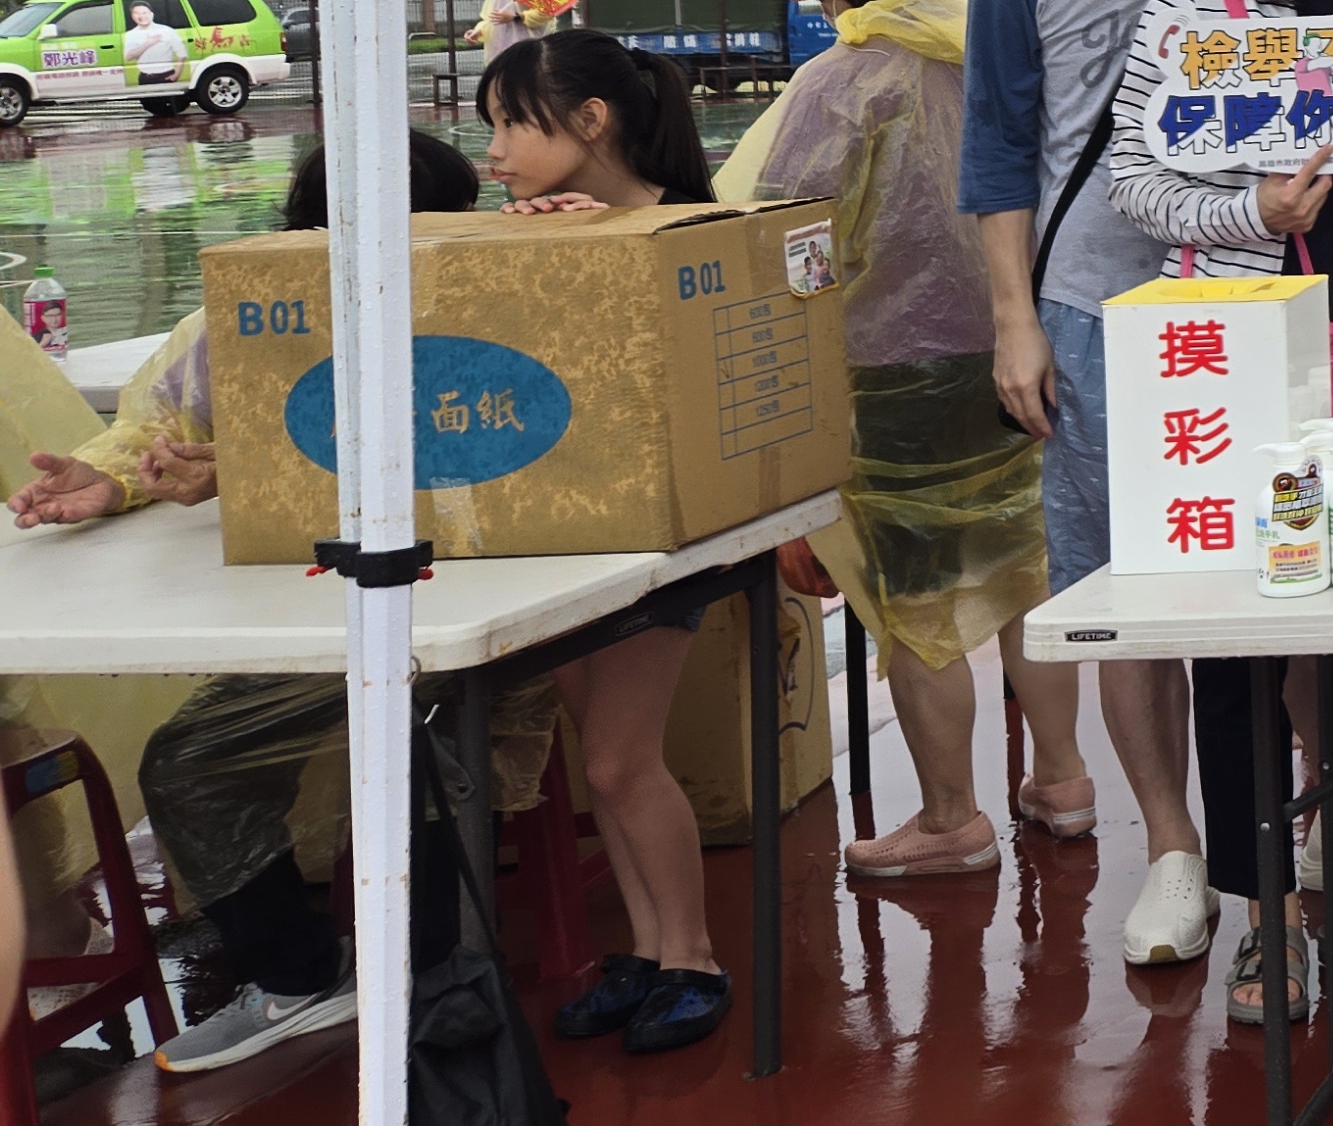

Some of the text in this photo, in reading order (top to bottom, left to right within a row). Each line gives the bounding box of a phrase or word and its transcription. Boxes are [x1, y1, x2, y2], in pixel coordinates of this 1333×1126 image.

[678, 260, 726, 301] B01
[237, 299, 310, 337] B01
[1158, 319, 1236, 554] 摸彩箱
[1071, 632, 1112, 641] LIFETIME
